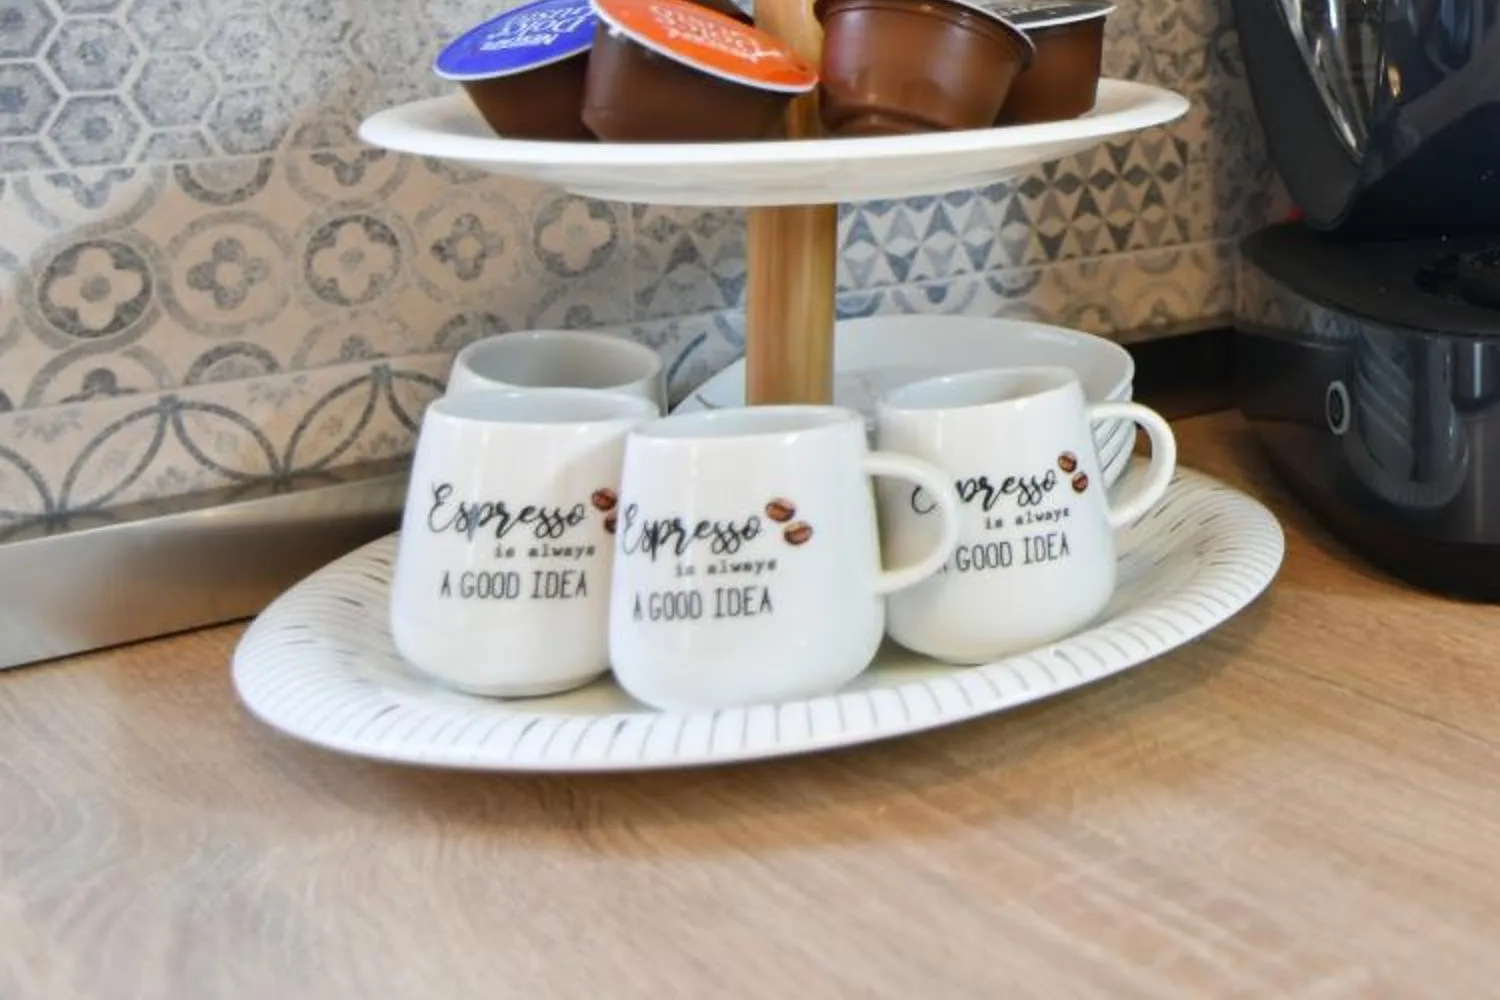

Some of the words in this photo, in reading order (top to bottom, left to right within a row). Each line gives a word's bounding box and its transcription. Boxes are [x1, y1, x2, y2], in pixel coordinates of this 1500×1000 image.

[428, 481, 586, 542] Espresso
[621, 502, 762, 562] Espresso
[955, 541, 1013, 573] GOOD
[1023, 531, 1071, 566] IDEA
[439, 570, 452, 599] A
[459, 570, 521, 600] GOOD
[530, 570, 588, 599] IDEA
[632, 592, 643, 622] A
[649, 589, 703, 622] GOOD
[713, 585, 774, 619] IDEA
